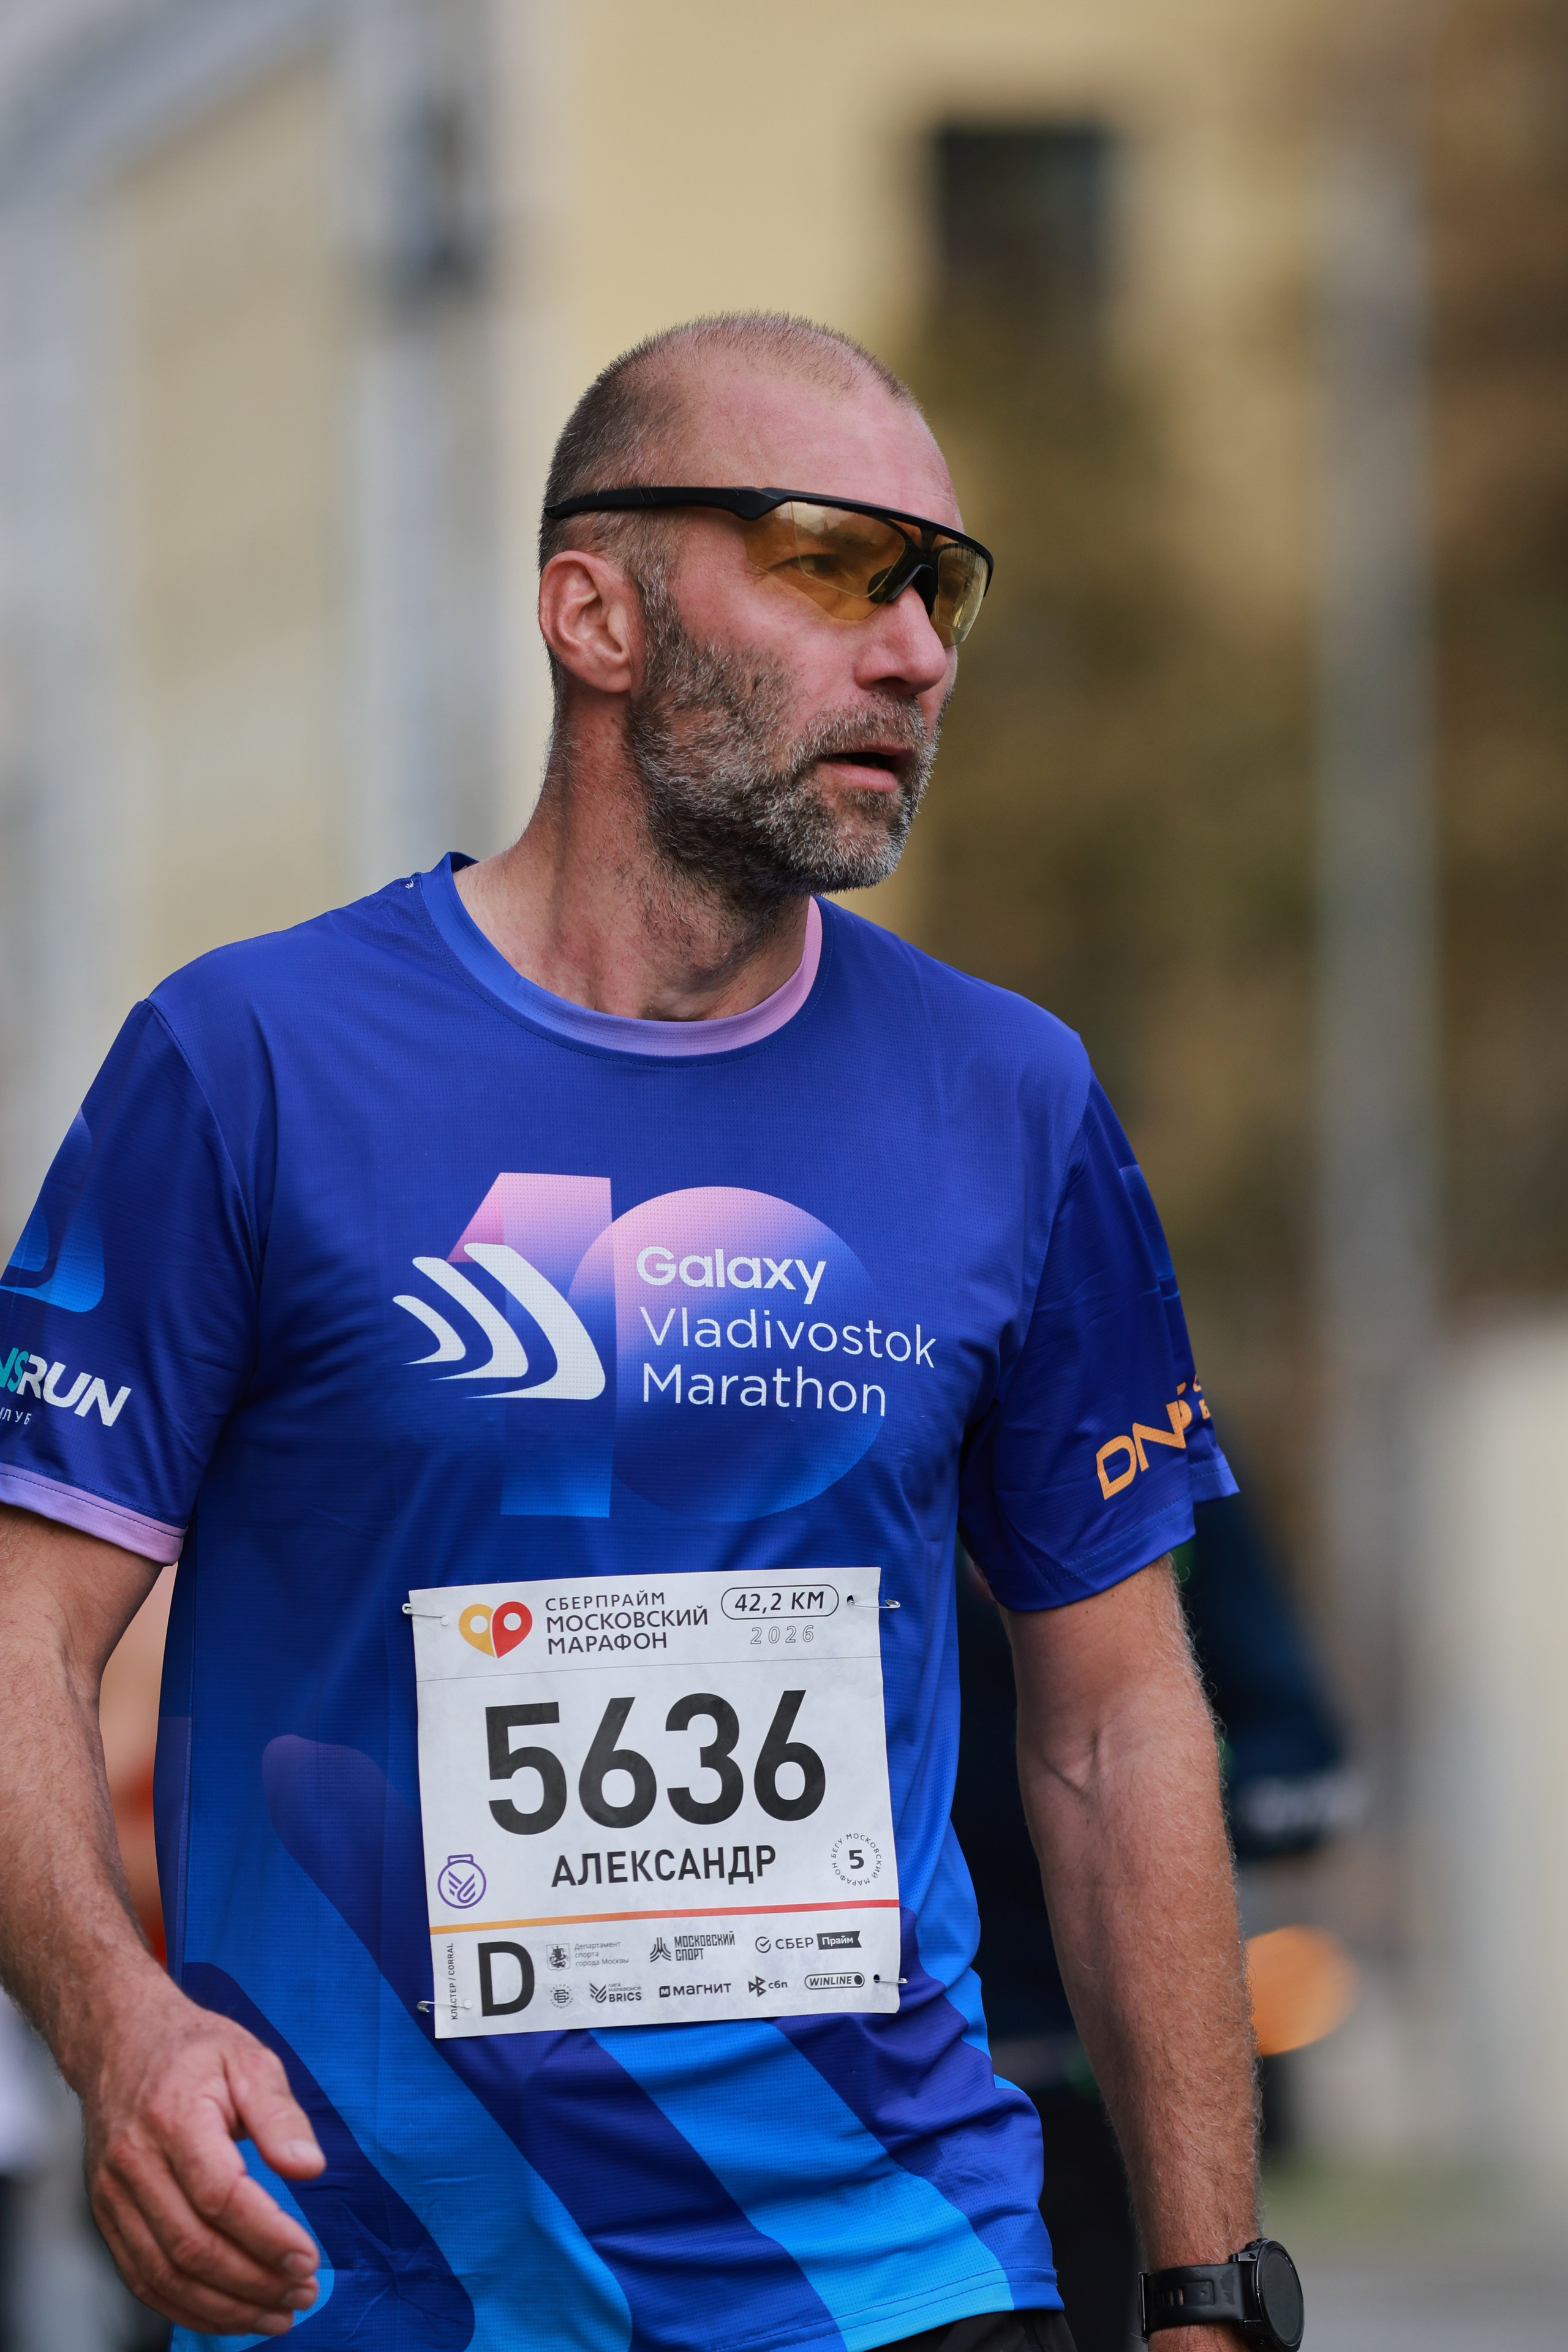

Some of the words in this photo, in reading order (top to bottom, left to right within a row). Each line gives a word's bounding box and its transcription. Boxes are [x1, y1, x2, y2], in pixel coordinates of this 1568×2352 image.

[636, 1246, 826, 1305] Galaxy
[640, 1306, 937, 1368] Vladivostok
[643, 1363, 886, 1416] Marathon
[545, 1589, 666, 1611] СБЕРПРАЙМ
[734, 1593, 782, 1614] 42,2
[791, 1591, 824, 1610] КМ
[546, 1605, 709, 1634] МОСКОВСКИЙ
[548, 1632, 668, 1655] МАРАФОН
[750, 1624, 815, 1645] 2026
[485, 1690, 826, 1836] 5636
[831, 1838, 843, 1858] БЕГУ
[846, 1833, 882, 1879] МОСКОВСКИЙ
[848, 1849, 864, 1869] 5
[551, 1845, 777, 1888] АЛЕКСАНДР
[832, 1862, 870, 1886] МАРАФОН
[574, 1942, 621, 1951] Департамент
[674, 1931, 736, 1948] МОСКОВСКИЙ
[775, 1937, 814, 1950] СБЕР
[822, 1936, 854, 1947] Прайм
[447, 1943, 455, 1975] CORRAL
[676, 1948, 704, 1961] СПОРТ
[477, 1941, 535, 2017] D
[768, 1980, 788, 1989] сбп
[809, 1975, 852, 1987] WINLINE
[609, 1991, 642, 2002] BRICS
